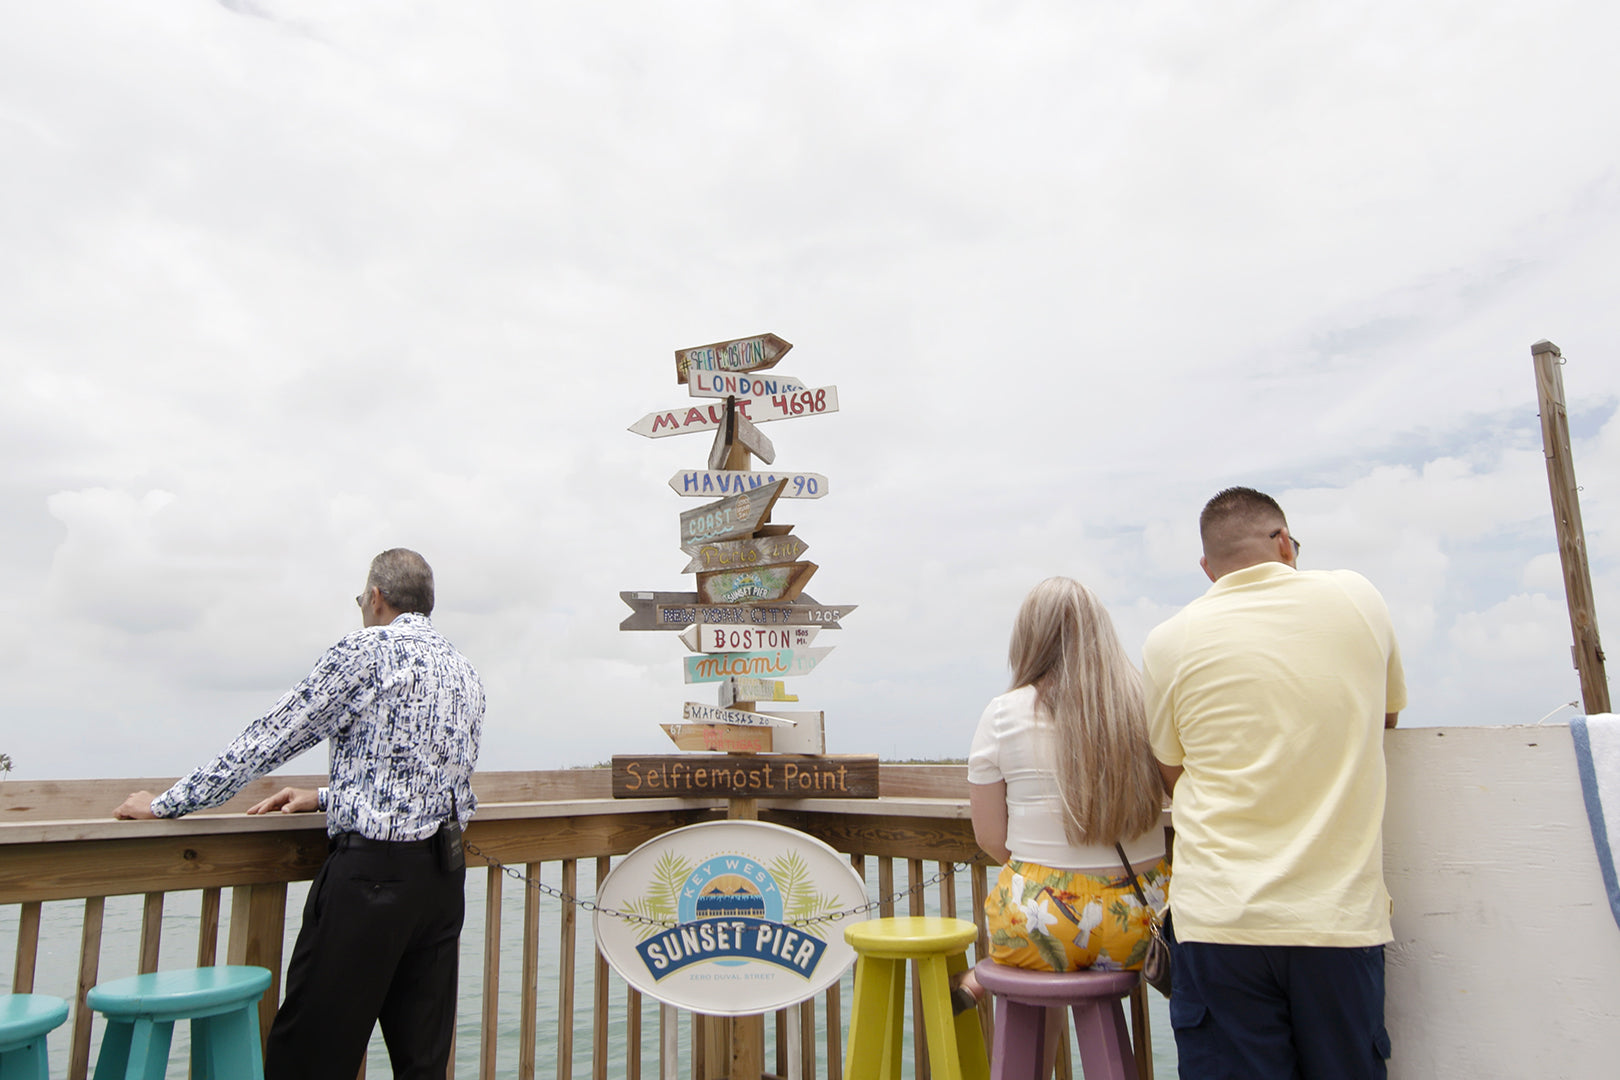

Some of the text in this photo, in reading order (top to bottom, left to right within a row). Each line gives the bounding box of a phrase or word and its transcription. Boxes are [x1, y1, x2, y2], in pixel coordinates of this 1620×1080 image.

[697, 374, 777, 397] LONDON
[793, 475, 818, 496] 90
[689, 508, 732, 536] COAST
[700, 545, 757, 566] Paris
[727, 586, 769, 603] SUNSET PIER
[663, 608, 840, 623] NEW YORK CITY 1205
[713, 629, 790, 649] BOSTON
[695, 652, 788, 678] miami
[670, 725, 682, 735] 67
[704, 739, 762, 751] TORTUGAS
[625, 761, 848, 791] Selfiemost Point
[683, 858, 776, 898] KEY WEST
[647, 921, 816, 970] SUNSET PIER
